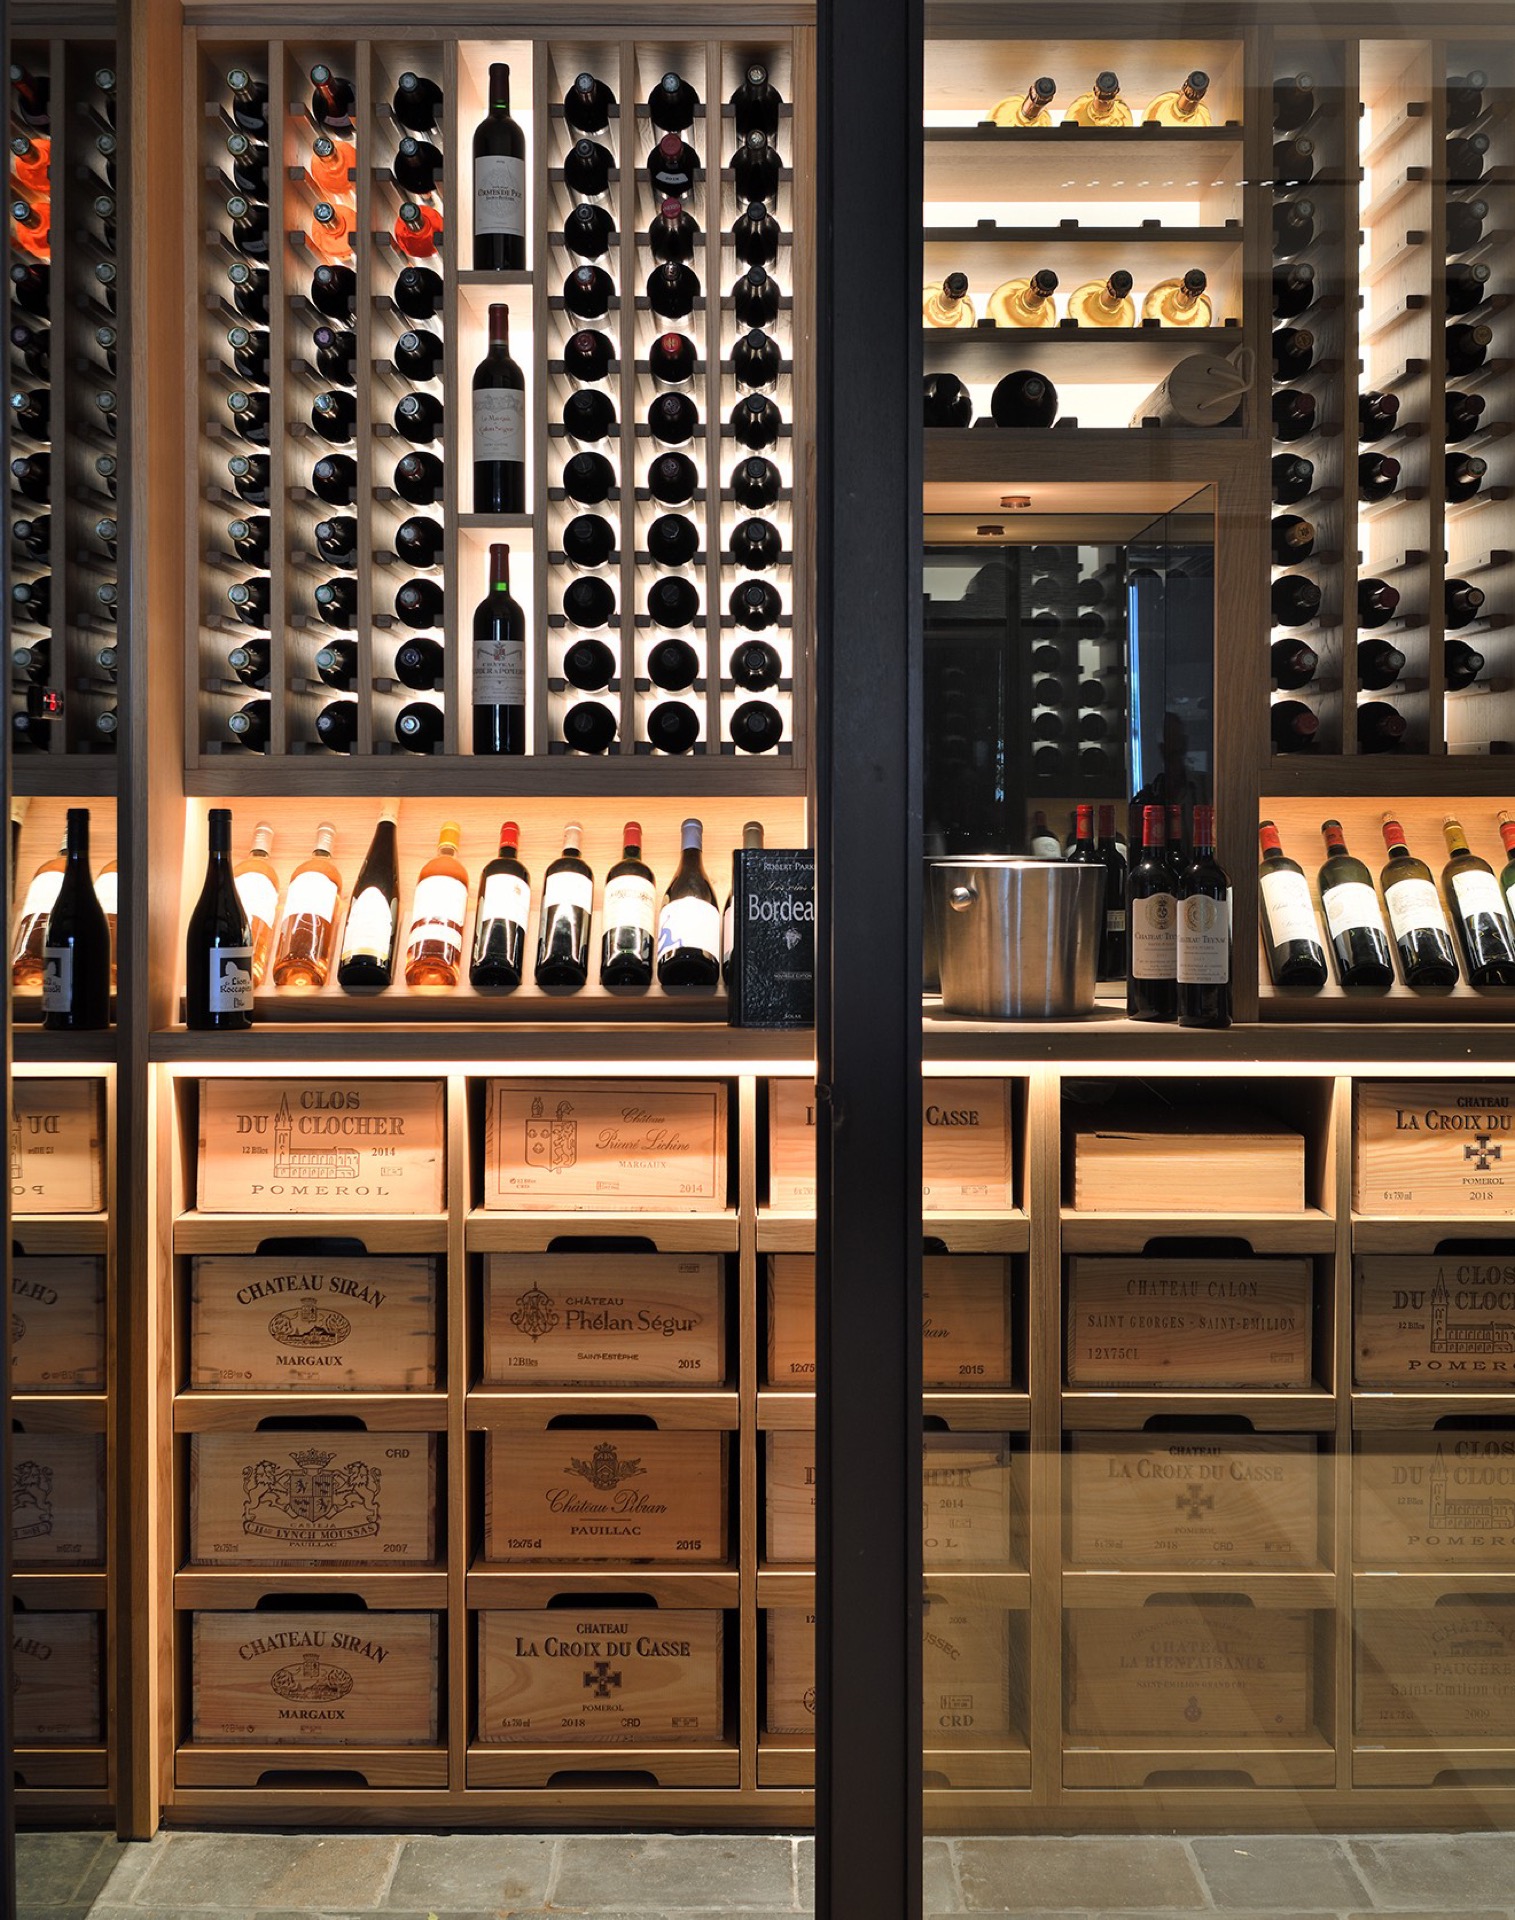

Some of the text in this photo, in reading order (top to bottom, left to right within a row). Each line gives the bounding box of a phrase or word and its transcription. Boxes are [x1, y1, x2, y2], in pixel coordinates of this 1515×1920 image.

[300, 1090, 361, 1110] CLOS
[1456, 1096, 1510, 1108] CHATEAU
[926, 1105, 980, 1125] CASSE
[1395, 1109, 1513, 1130] LA CROIX DU
[236, 1115, 405, 1136] DU CLOCHER
[242, 1146, 251, 1154] 12
[371, 1147, 396, 1157] 2014
[618, 1160, 667, 1169] MARGAUX
[1462, 1177, 1505, 1185] POMEROL
[251, 1184, 390, 1196] POMEROL
[679, 1183, 703, 1194] 2014
[1469, 1191, 1494, 1200] 2018
[236, 1274, 387, 1310] CHATEAU SIRAN
[1126, 1279, 1259, 1297] CHATEAU CALON
[565, 1296, 624, 1306] CHÂTEAU
[1392, 1290, 1515, 1310] DU CLOC
[565, 1309, 698, 1337] Phélan Ségur
[1087, 1314, 1124, 1328] SAINT
[1129, 1315, 1185, 1329] GEORGES
[275, 1355, 343, 1366] MARGAUX
[678, 1359, 701, 1369] 2015
[1408, 1360, 1515, 1371] POMER
[959, 1364, 984, 1375] 2015
[385, 1449, 410, 1459] CRD
[1136, 1458, 1194, 1480] CROIX
[1391, 1466, 1515, 1485] DU CLOC
[545, 1488, 667, 1514] Château Pibran
[939, 1499, 964, 1509] 2014
[276, 1529, 316, 1539] LYNCH
[320, 1524, 376, 1539] MOUSSAS
[570, 1526, 642, 1536] PAUILLAC
[507, 1539, 533, 1549] 12x75
[676, 1540, 702, 1550] 2015
[1154, 1540, 1178, 1550] 2018
[1407, 1535, 1515, 1546] POMER
[383, 1543, 408, 1553] 2007
[576, 1623, 628, 1634] CHATEAU
[238, 1631, 390, 1665] CHATEAU SIRAN
[515, 1636, 691, 1657] LA CROIX DU CASSE
[582, 1704, 624, 1712] POMEROL
[278, 1709, 345, 1719] MARGAUX
[561, 1718, 586, 1728] 2018
[621, 1717, 641, 1728] CRD
[939, 1714, 975, 1728] CRD
